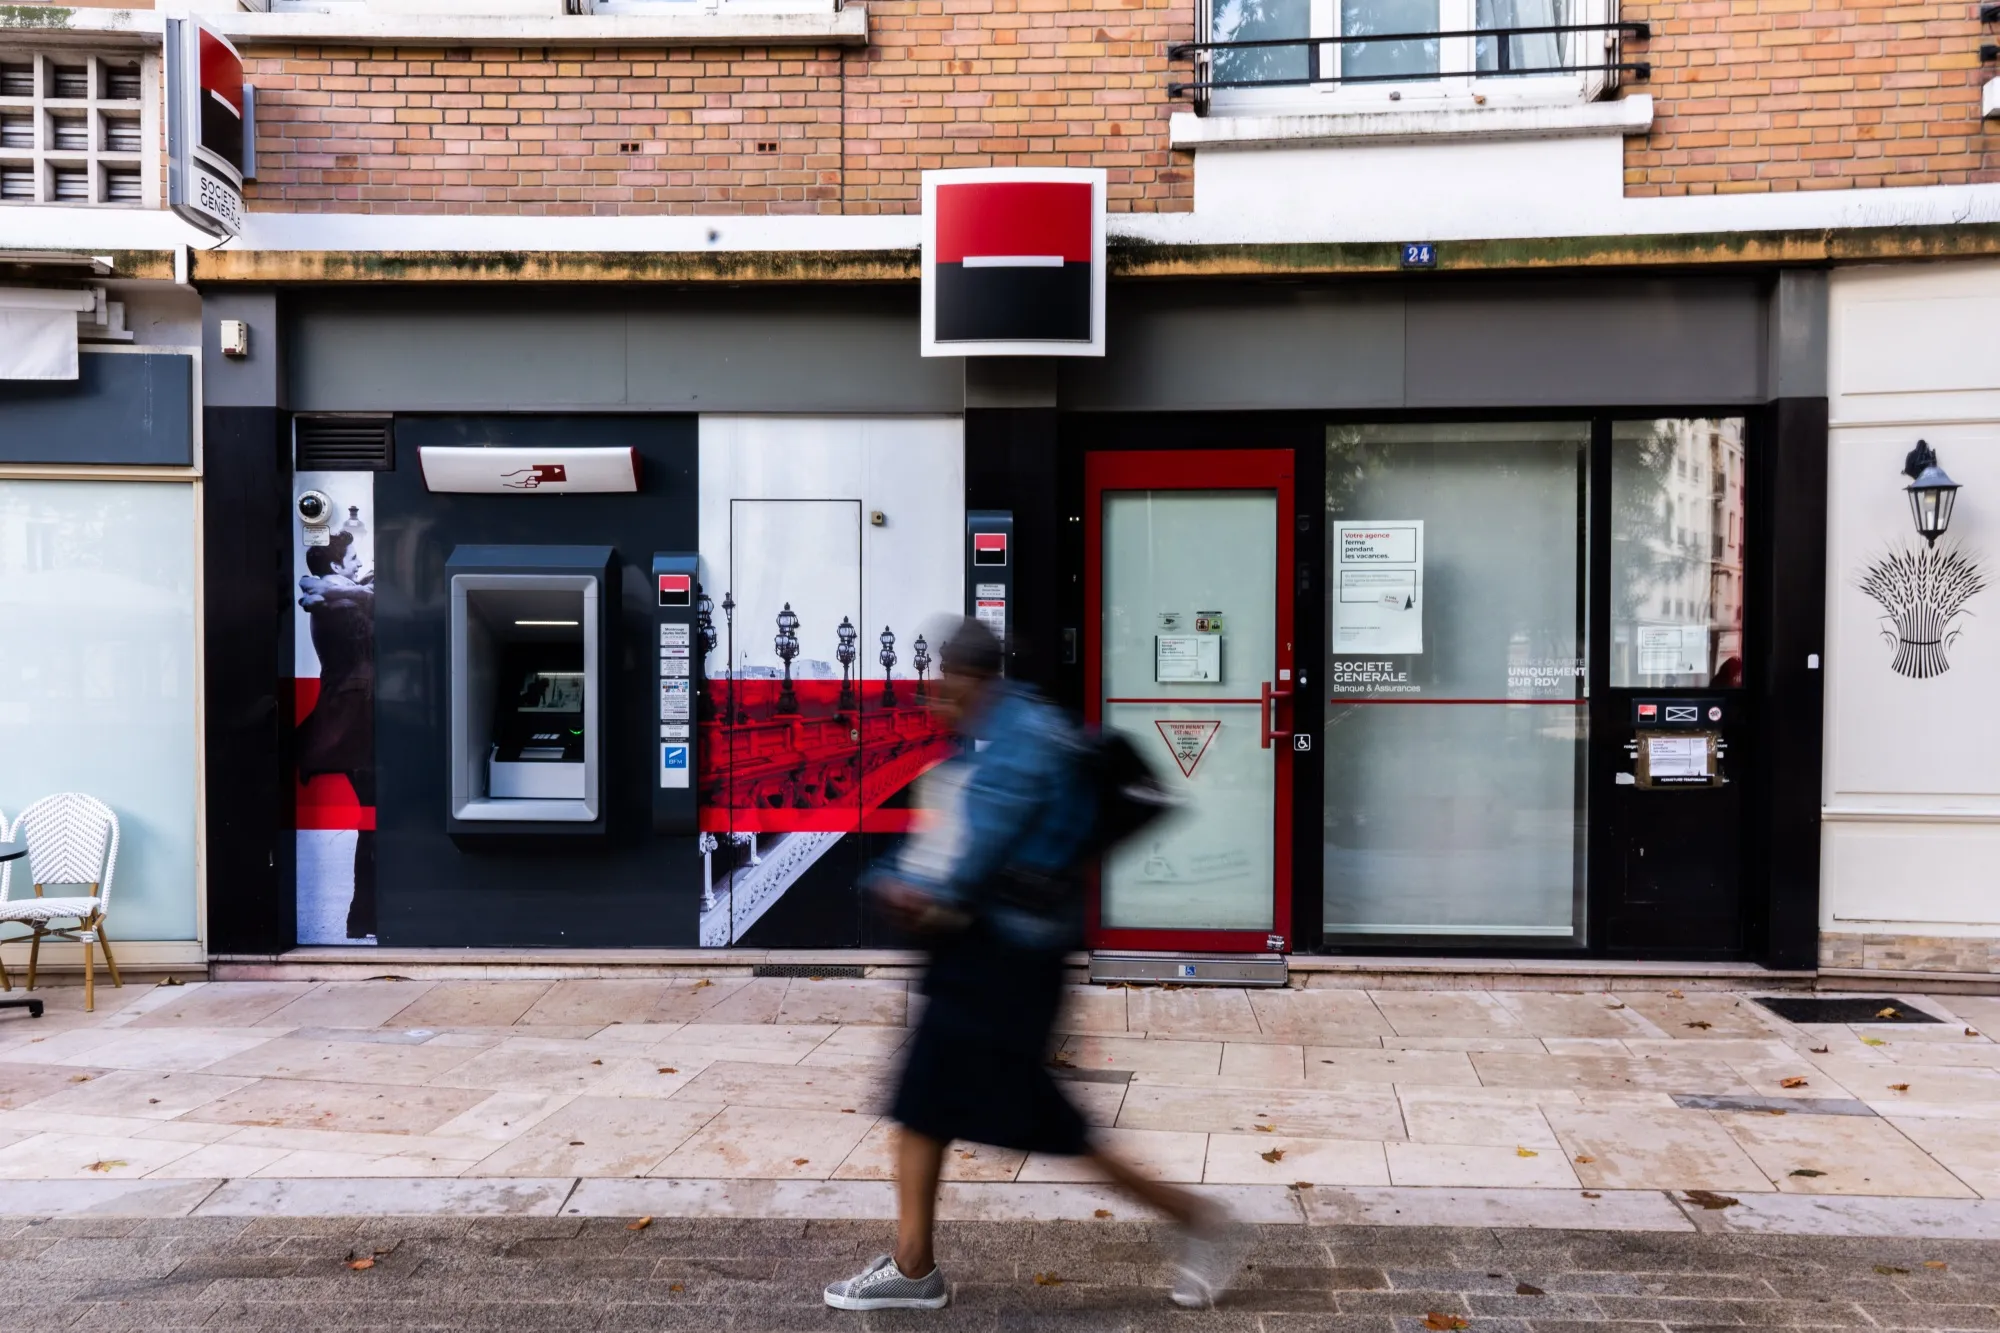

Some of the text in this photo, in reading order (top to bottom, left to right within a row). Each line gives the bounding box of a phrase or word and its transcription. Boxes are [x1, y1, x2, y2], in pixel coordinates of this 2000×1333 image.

[201, 177, 236, 206] SOCIETE
[200, 192, 241, 230] GENERALE
[1408, 246, 1430, 263] 24
[1333, 661, 1393, 672] SOCIETE
[1545, 658, 1585, 666] OUVERTE
[1333, 672, 1407, 682] GENERALE
[1508, 667, 1586, 677] UNIQUEMENT
[1507, 677, 1559, 687] SUR RDV
[1333, 684, 1421, 693] Banque & Assurances
